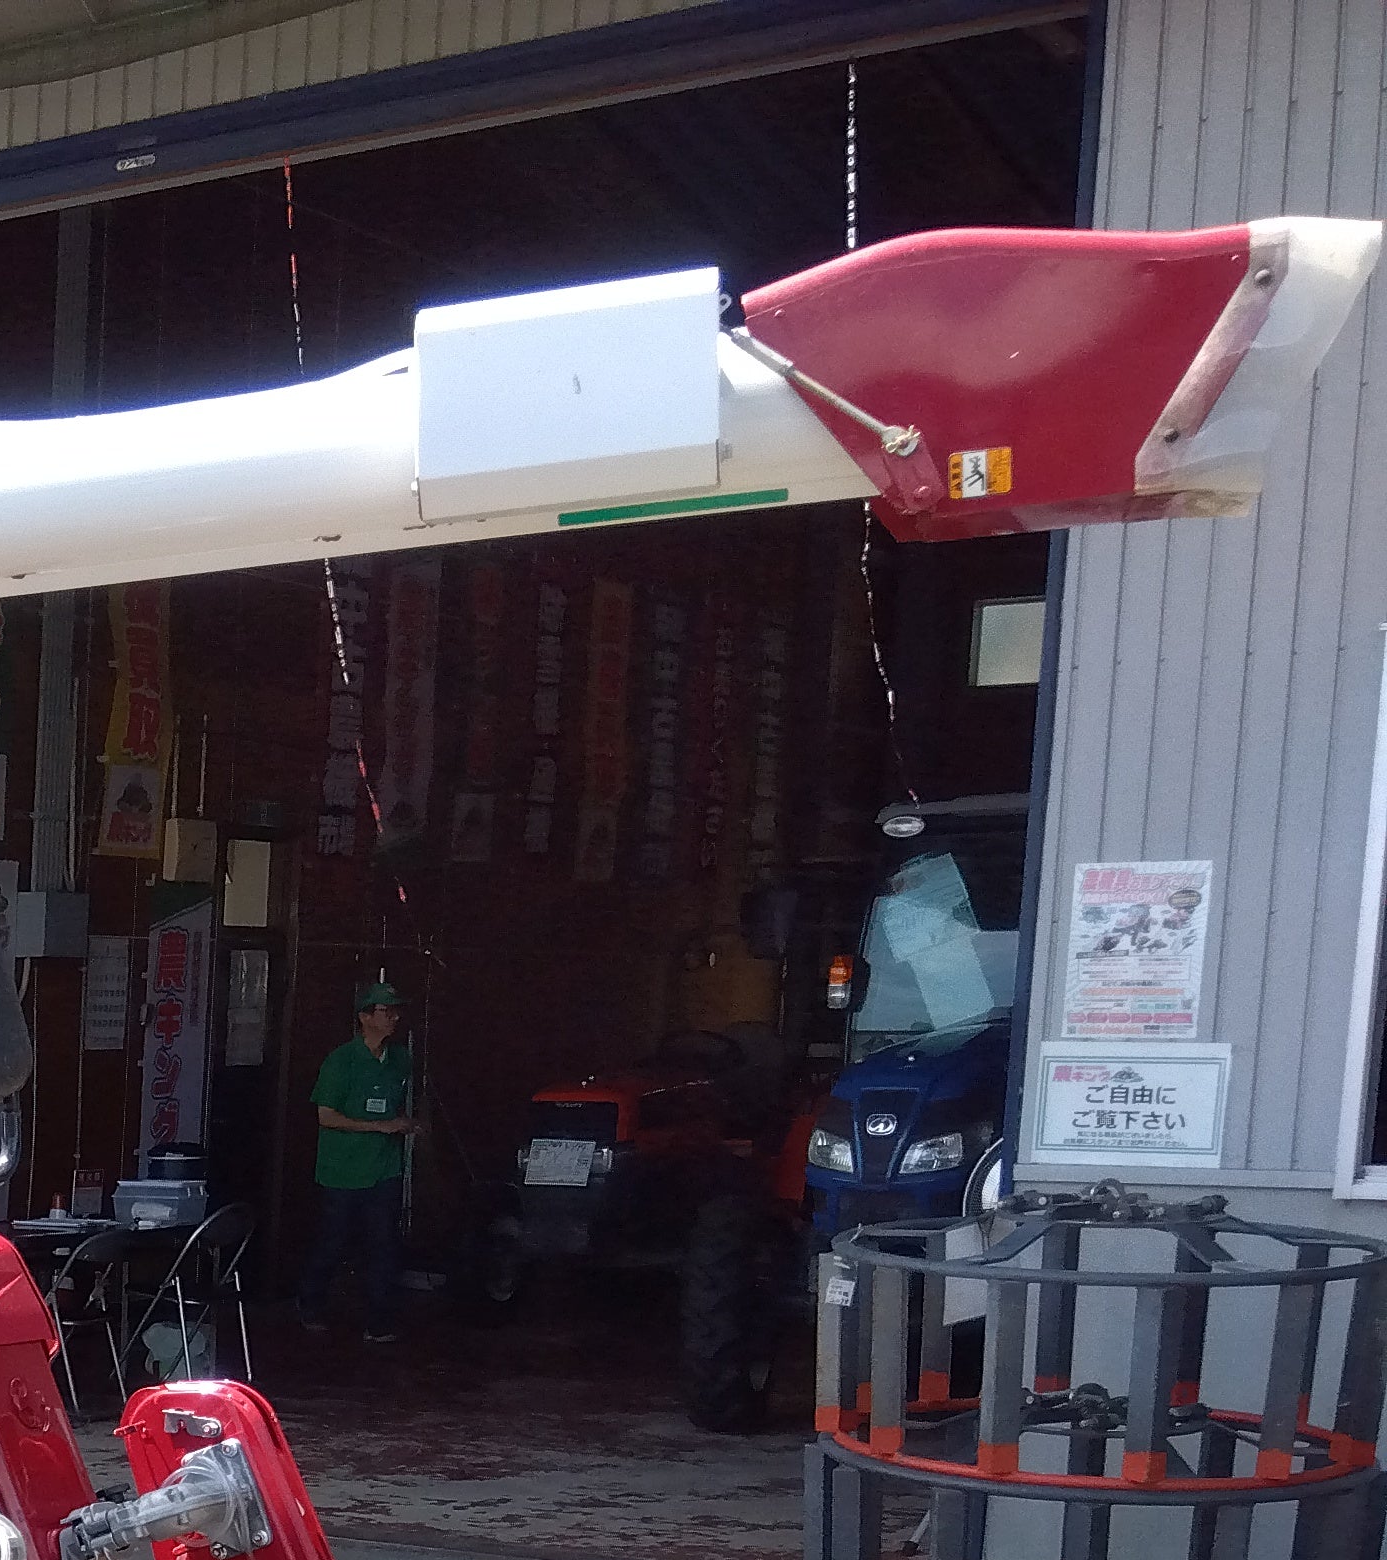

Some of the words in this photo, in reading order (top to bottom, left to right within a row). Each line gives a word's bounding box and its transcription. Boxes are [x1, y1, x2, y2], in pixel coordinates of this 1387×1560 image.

[1085, 1083, 1177, 1105] ご自由に
[1071, 1109, 1186, 1131] ご覧下さい
